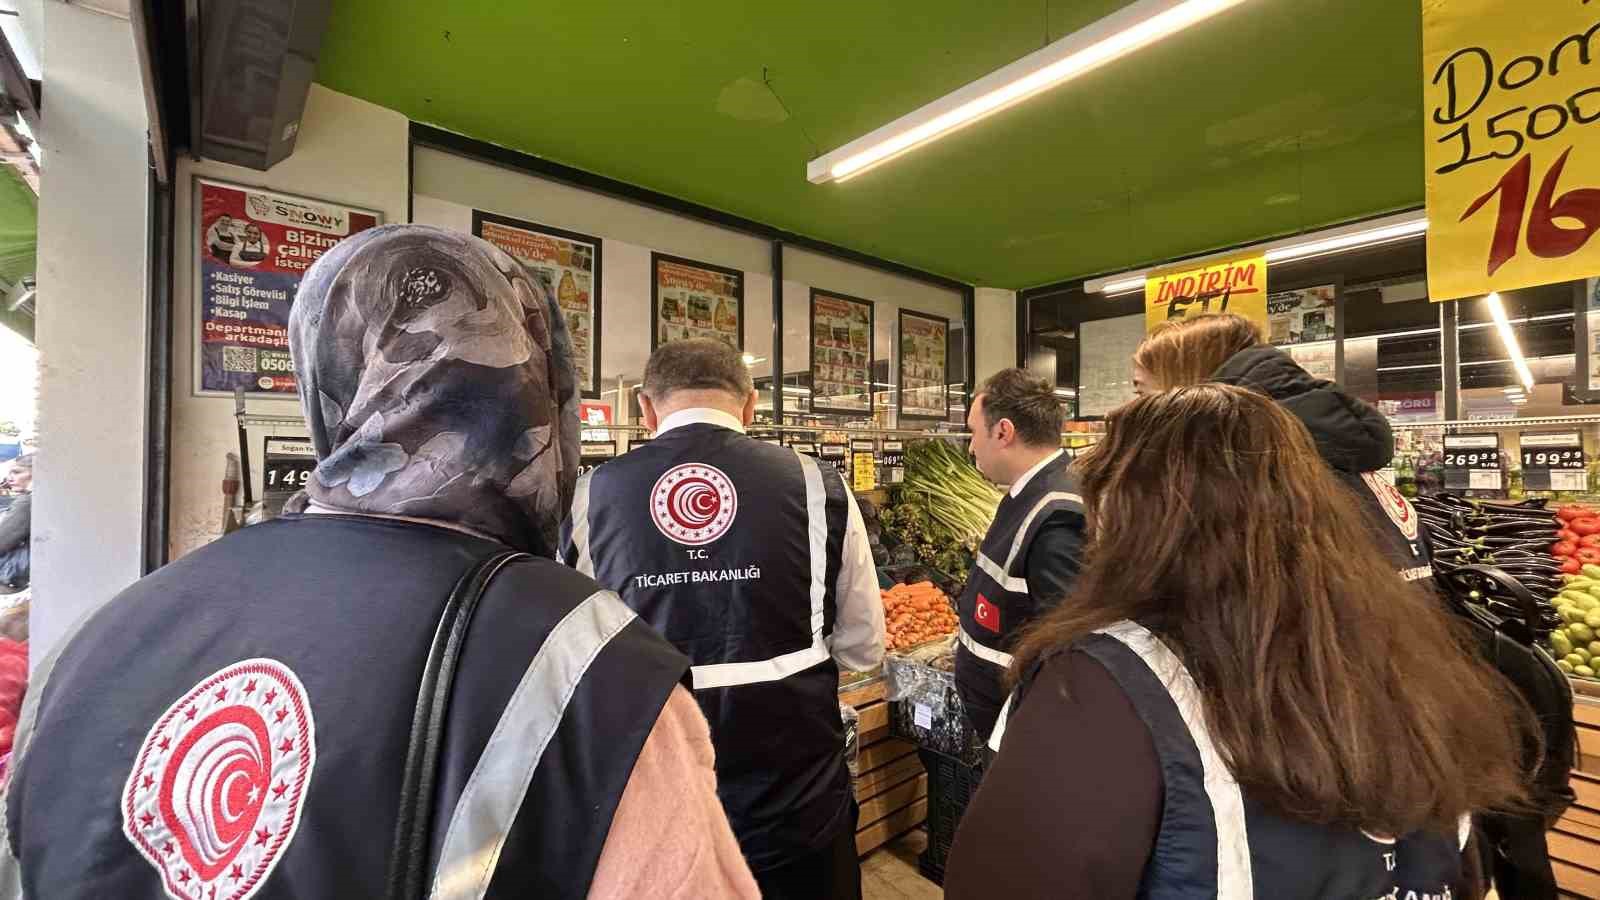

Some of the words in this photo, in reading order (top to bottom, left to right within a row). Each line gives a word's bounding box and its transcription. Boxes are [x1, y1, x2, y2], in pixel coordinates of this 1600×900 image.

[275, 206, 343, 227] SNOWY
[215, 272, 254, 284] Kasiyer
[215, 283, 241, 296] Satış
[242, 286, 287, 301] Görevlisi
[215, 295, 240, 308] Bilgi
[215, 307, 247, 320] Kasap
[1445, 454, 1478, 465] 269
[1524, 453, 1560, 465] 199
[686, 549, 709, 560] T.C.
[635, 571, 690, 588] TİCARET
[691, 565, 760, 583] BAKANLIĞI
